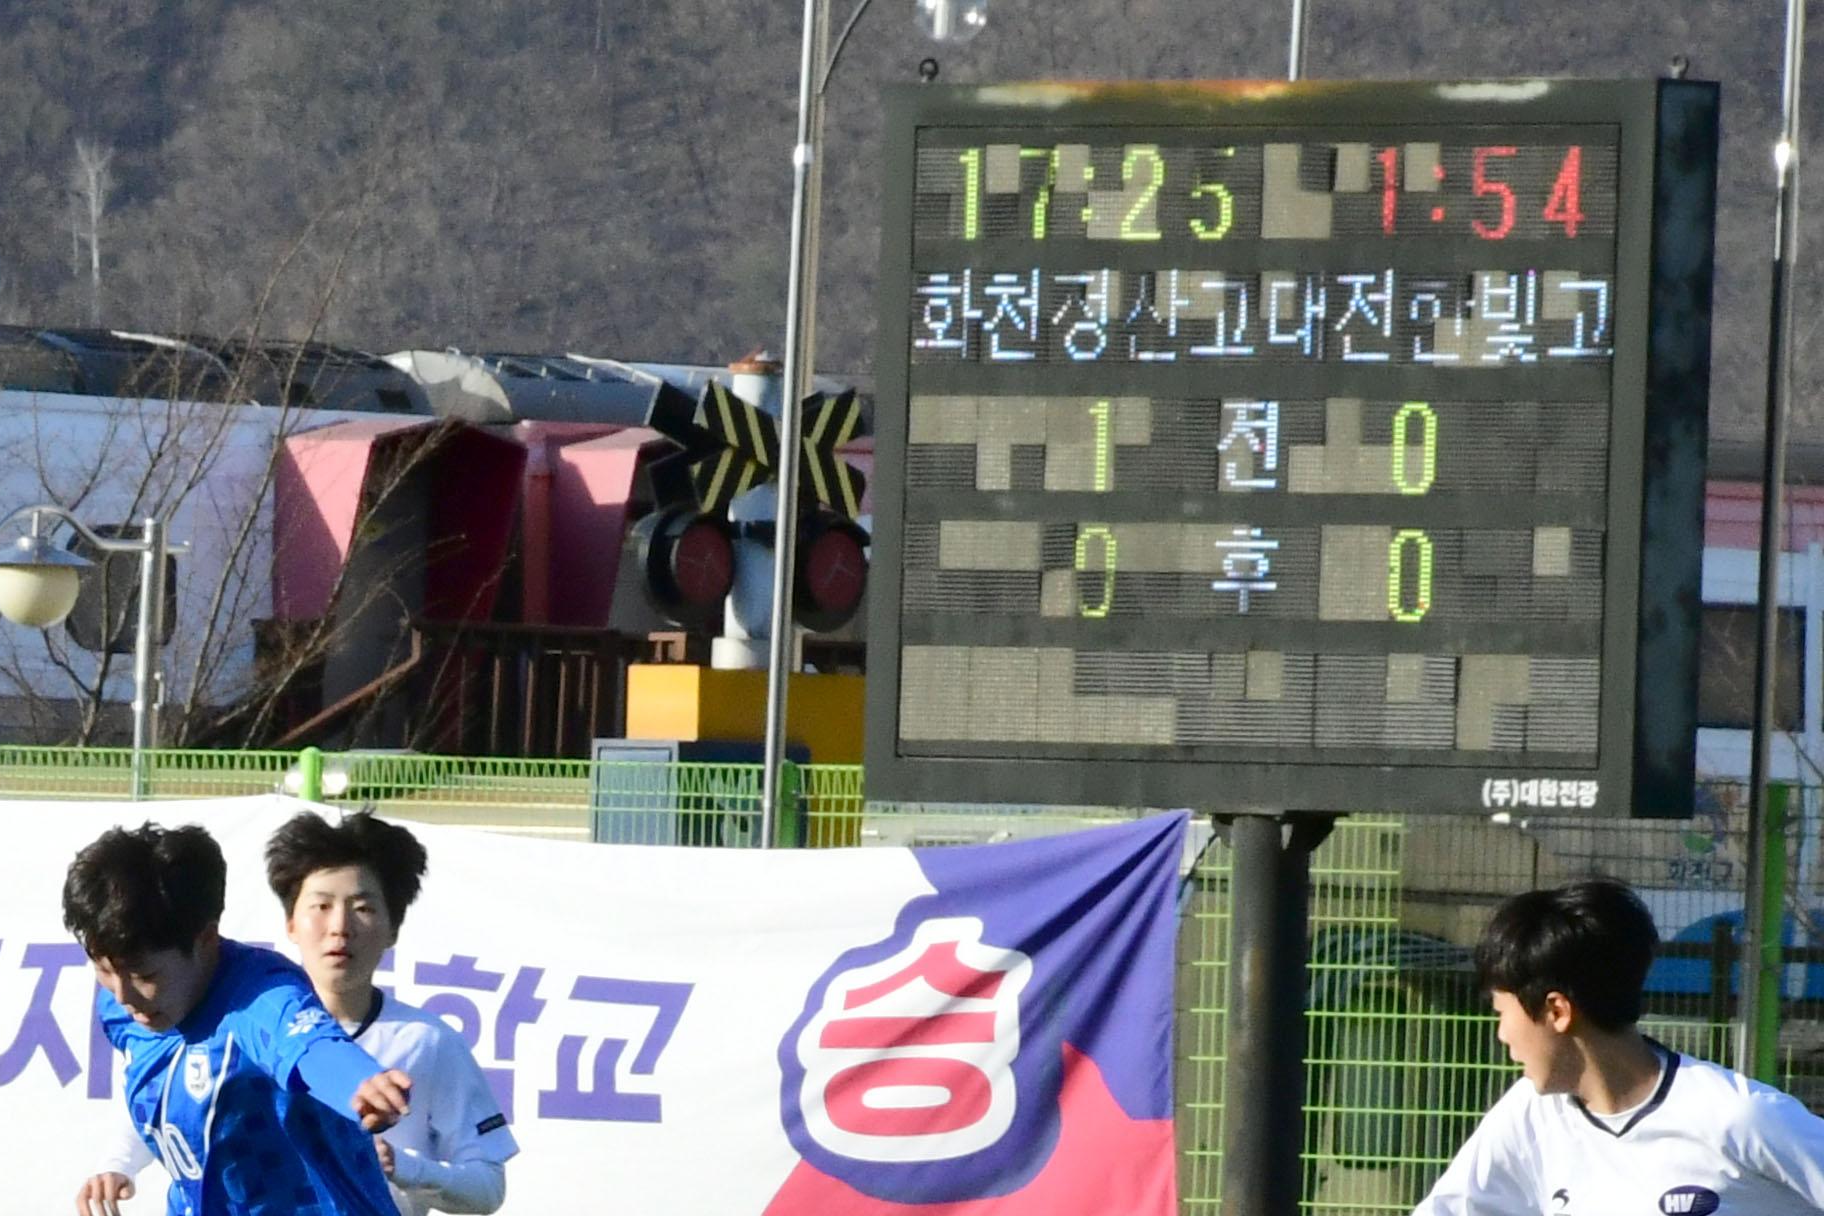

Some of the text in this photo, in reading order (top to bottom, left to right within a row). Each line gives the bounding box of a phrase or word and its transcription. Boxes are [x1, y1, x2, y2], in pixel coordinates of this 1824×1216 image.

[959, 146, 1586, 239] 17:25 1:54
[1087, 400, 1437, 494] 1 전 0
[1075, 527, 1434, 621] 0 후 0
[1482, 778, 1599, 808] (주)대한전광
[808, 929, 1020, 1150] 승
